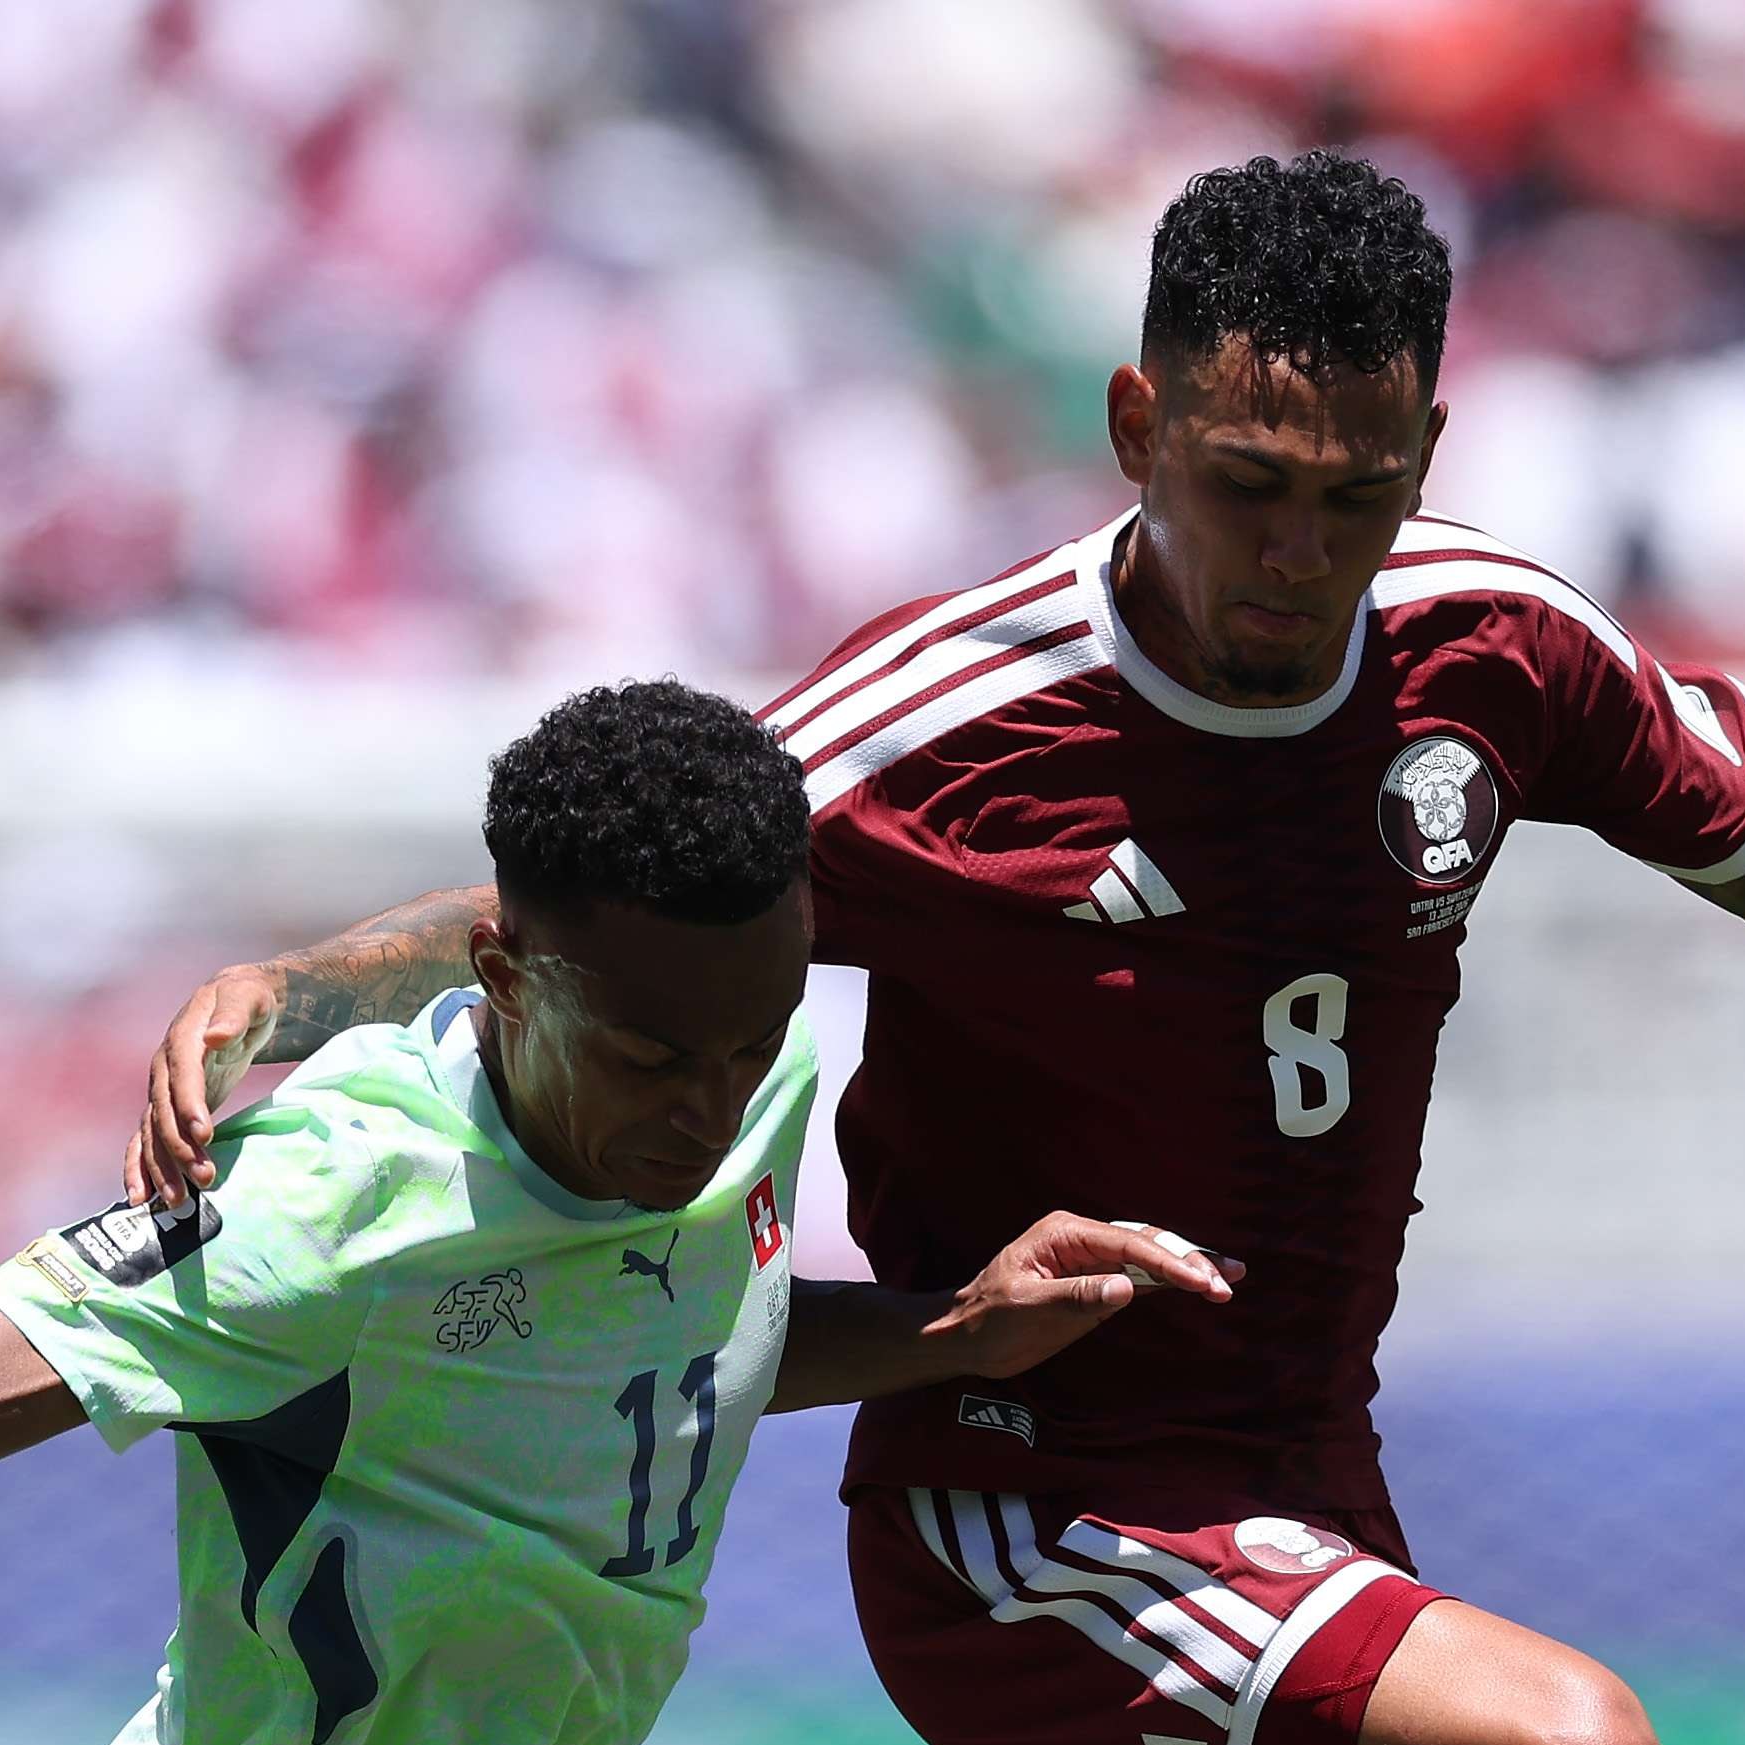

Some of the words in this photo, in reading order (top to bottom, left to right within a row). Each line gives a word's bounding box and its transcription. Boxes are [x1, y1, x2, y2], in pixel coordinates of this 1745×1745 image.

[1422, 839, 1474, 874] QFA
[1263, 973, 1351, 1138] 8
[432, 1280, 490, 1320] ASF
[597, 1350, 717, 1577] 11
